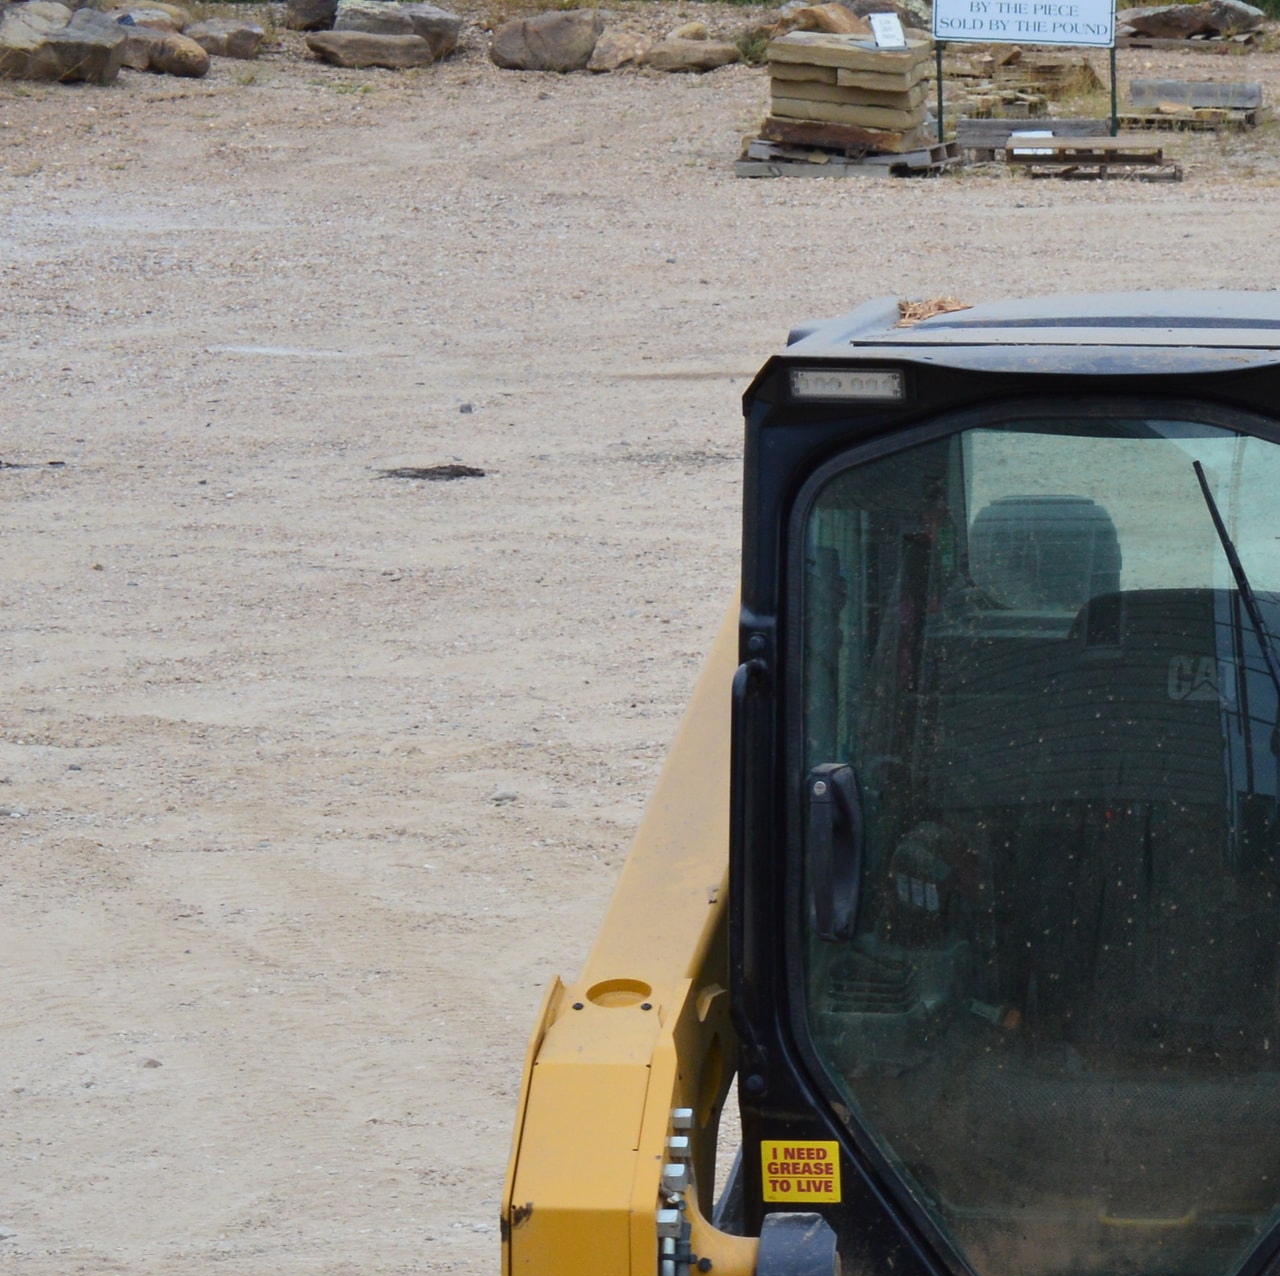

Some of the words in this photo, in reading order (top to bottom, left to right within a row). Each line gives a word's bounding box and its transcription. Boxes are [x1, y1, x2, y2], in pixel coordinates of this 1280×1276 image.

[969, 1, 990, 13] BY
[997, 2, 1028, 14] THE
[1033, 4, 1079, 17] PIECE
[939, 17, 984, 30] SOLD
[989, 19, 1009, 31] BY
[1015, 20, 1047, 32] THE
[1052, 22, 1108, 35] POUND
[772, 1148, 778, 1160] I
[783, 1148, 828, 1160] NEED
[767, 1162, 834, 1175] GREASE
[769, 1180, 791, 1192] TO
[797, 1180, 833, 1193] LIVE
